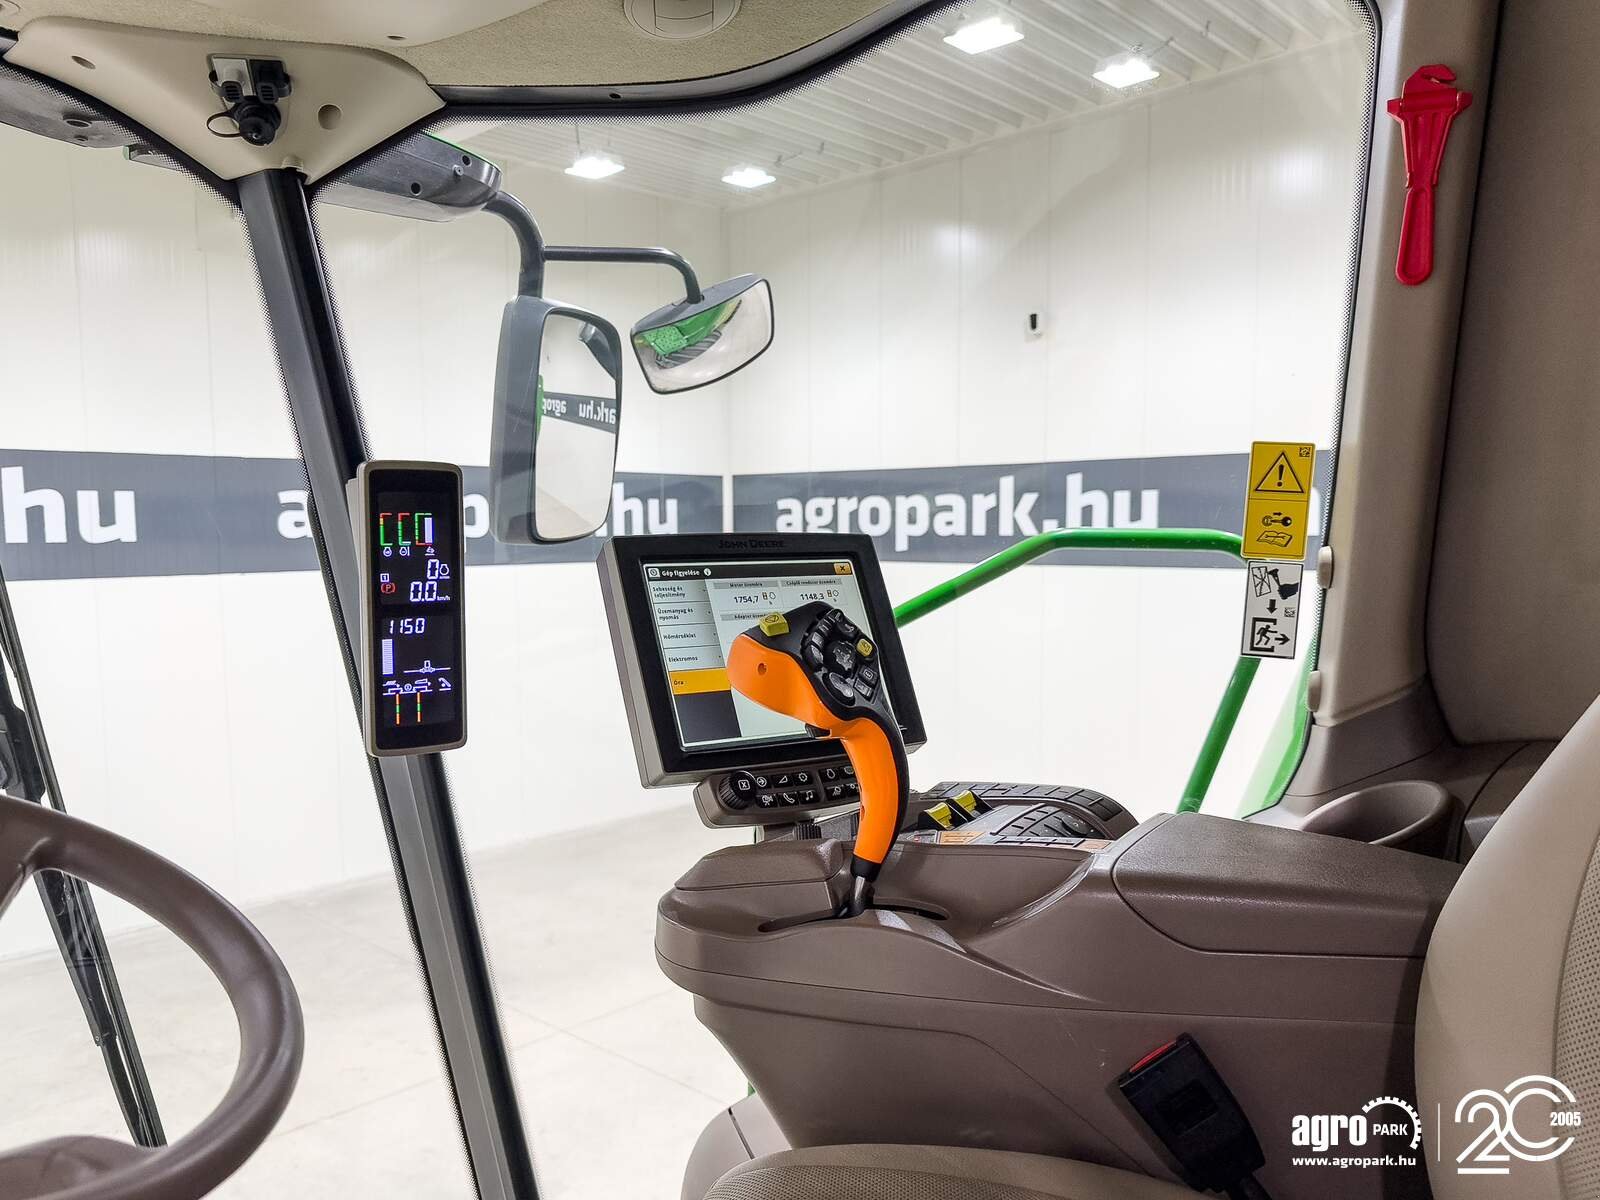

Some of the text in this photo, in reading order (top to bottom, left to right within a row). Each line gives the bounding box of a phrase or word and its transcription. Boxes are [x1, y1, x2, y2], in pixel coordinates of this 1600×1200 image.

[776, 472, 1160, 552] agropark.hu
[410, 581, 437, 602] 0.0
[389, 617, 426, 635] 1150
